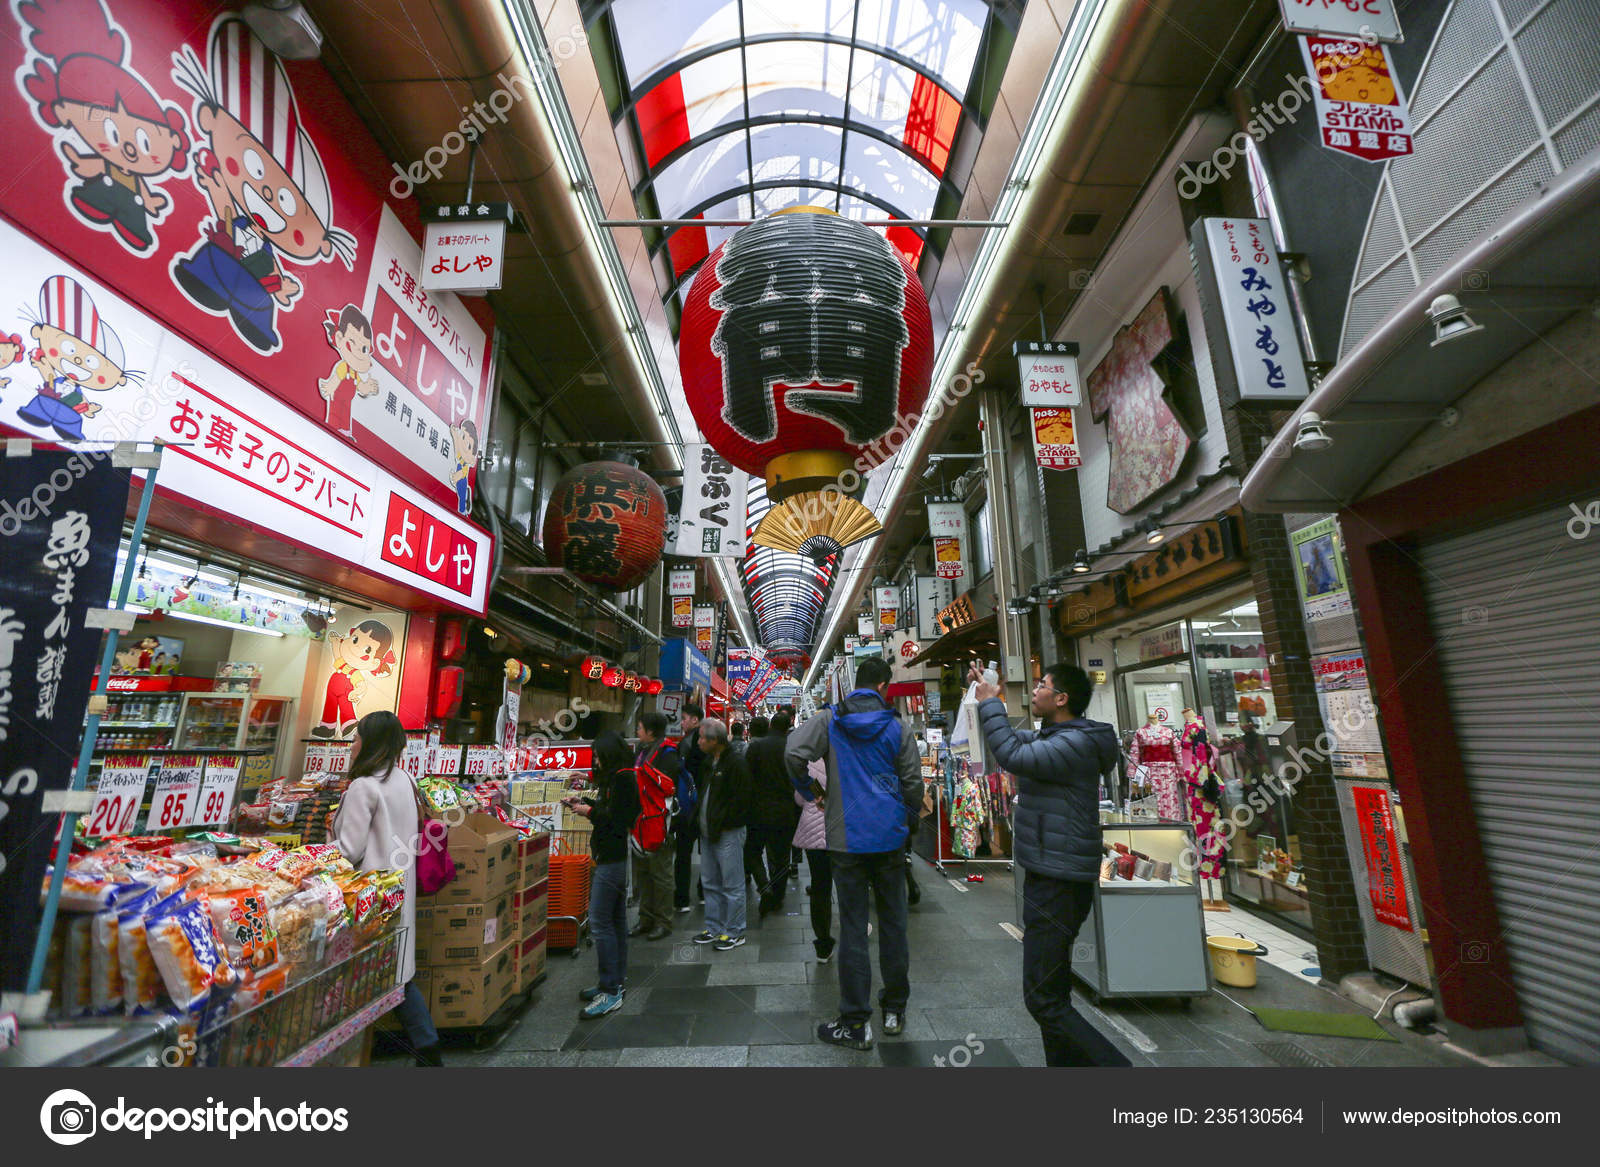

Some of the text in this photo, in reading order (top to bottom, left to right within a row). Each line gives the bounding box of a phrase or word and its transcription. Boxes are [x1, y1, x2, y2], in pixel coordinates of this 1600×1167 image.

[1328, 100, 1395, 118] フレッシュ
[1325, 112, 1404, 131] STAMP
[1329, 129, 1408, 152] 加盟店
[437, 234, 491, 246] お菓子のデパート
[1247, 222, 1269, 265] きもの
[431, 254, 493, 274] よしや
[388, 258, 474, 368] お菓子のデパート
[1240, 267, 1287, 389] みやもと
[376, 312, 468, 422] よしや
[1029, 379, 1073, 394] みやもと
[385, 391, 451, 459] 黒門市場店
[169, 398, 364, 522] お菓子のデパート
[389, 509, 473, 586] よしや
[728, 664, 751, 672] Eat in
[305, 756, 324, 772] 198
[328, 757, 345, 773] 119
[439, 759, 456, 775] 119
[467, 759, 484, 775] 139
[160, 793, 187, 826] 85
[203, 791, 225, 823] 99
